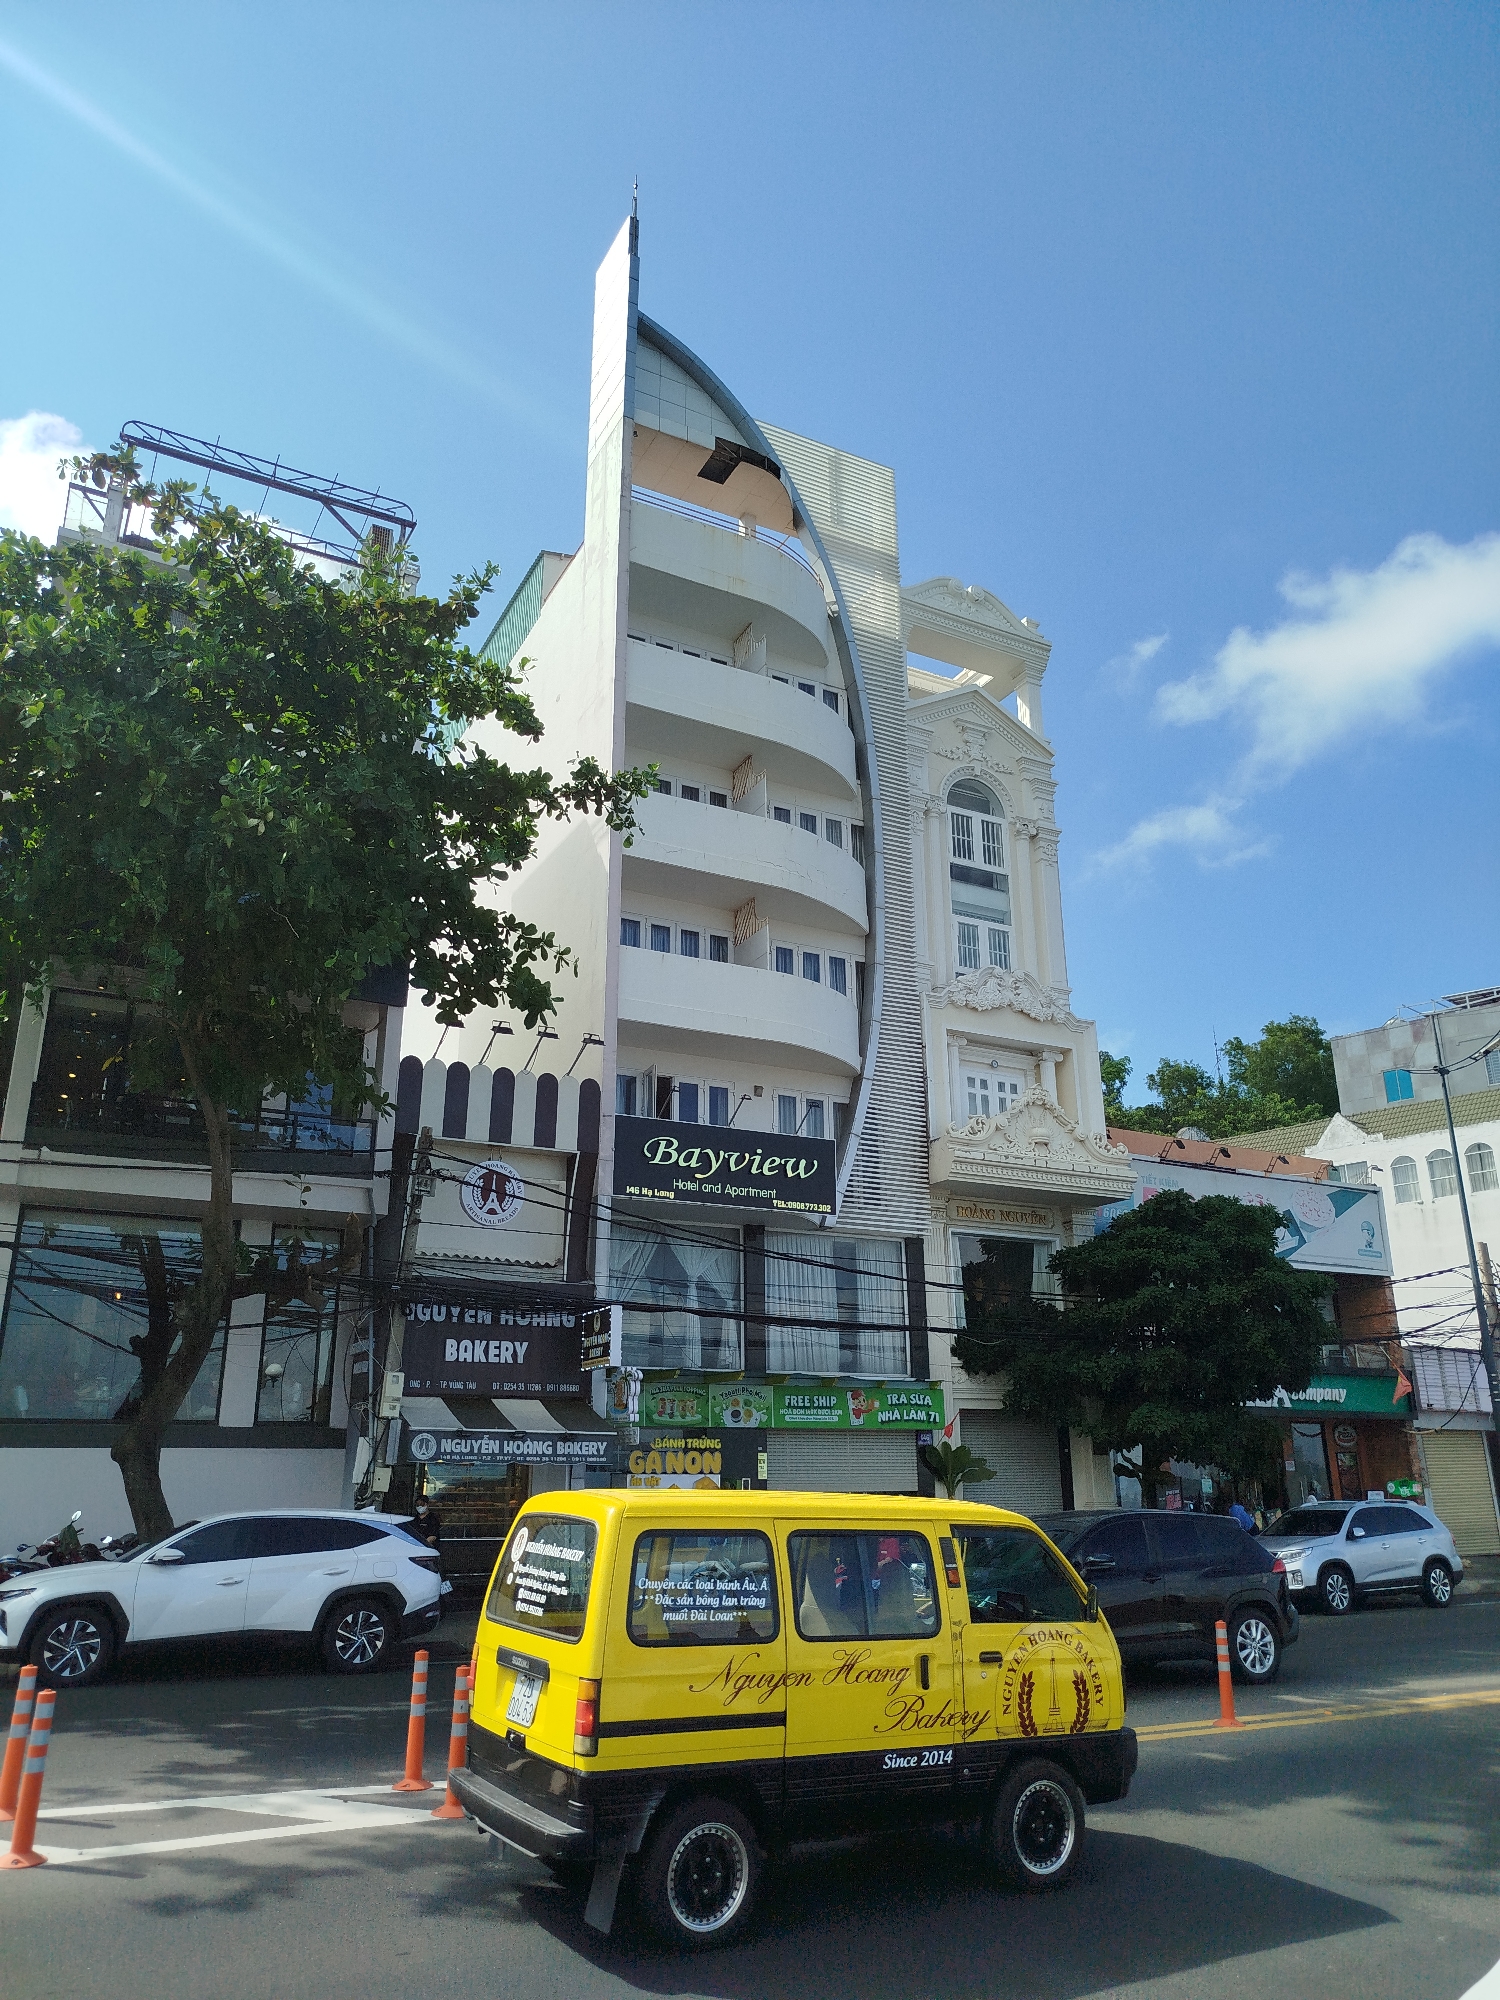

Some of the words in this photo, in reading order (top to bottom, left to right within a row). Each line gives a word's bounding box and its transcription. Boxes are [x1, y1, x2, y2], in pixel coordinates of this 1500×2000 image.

[643, 1136, 818, 1179] Bayview
[626, 1186, 640, 1195] 146
[654, 1189, 675, 1200] Long
[673, 1178, 699, 1192] Hotel
[702, 1182, 722, 1194] and
[725, 1183, 777, 1199] Apartment
[466, 1203, 497, 1225] ARTISANAL
[497, 1207, 519, 1224] BREADS
[955, 1203, 996, 1221] HOÀNG
[445, 1338, 529, 1364] BAKERY
[784, 1395, 811, 1407] FREE
[813, 1395, 837, 1407] SHIP
[886, 1391, 908, 1406] TRÀ
[877, 1407, 901, 1423] NHÀ
[903, 1407, 927, 1423] LÀM
[440, 1435, 500, 1454] NGUYỄN
[503, 1440, 553, 1455] HOÀNG
[556, 1441, 608, 1456] BAKERY
[654, 1435, 686, 1449] BÁNH
[665, 1450, 722, 1474] NON
[638, 1577, 676, 1592] Chuyên
[676, 1578, 694, 1591] các
[695, 1578, 715, 1593] loại
[716, 1578, 741, 1591] bánh
[741, 1577, 758, 1592] Âu,
[760, 1577, 768, 1591] Á
[675, 1593, 695, 1606] sản
[695, 1594, 720, 1608] bông
[721, 1595, 739, 1606] lan
[739, 1594, 766, 1608] trứng
[663, 1607, 688, 1621] muối
[690, 1608, 707, 1621] Đài
[511, 1655, 530, 1669] SUZUKI
[689, 1652, 816, 1707] Nguyen
[822, 1648, 911, 1697] Hoang
[1002, 1641, 1029, 1716] NGUYEN
[1027, 1629, 1073, 1649] HOANG
[1074, 1640, 1104, 1707] BAKERY
[873, 1694, 991, 1740] Bakery
[882, 1754, 918, 1770] Since
[920, 1750, 953, 1767] 2014
